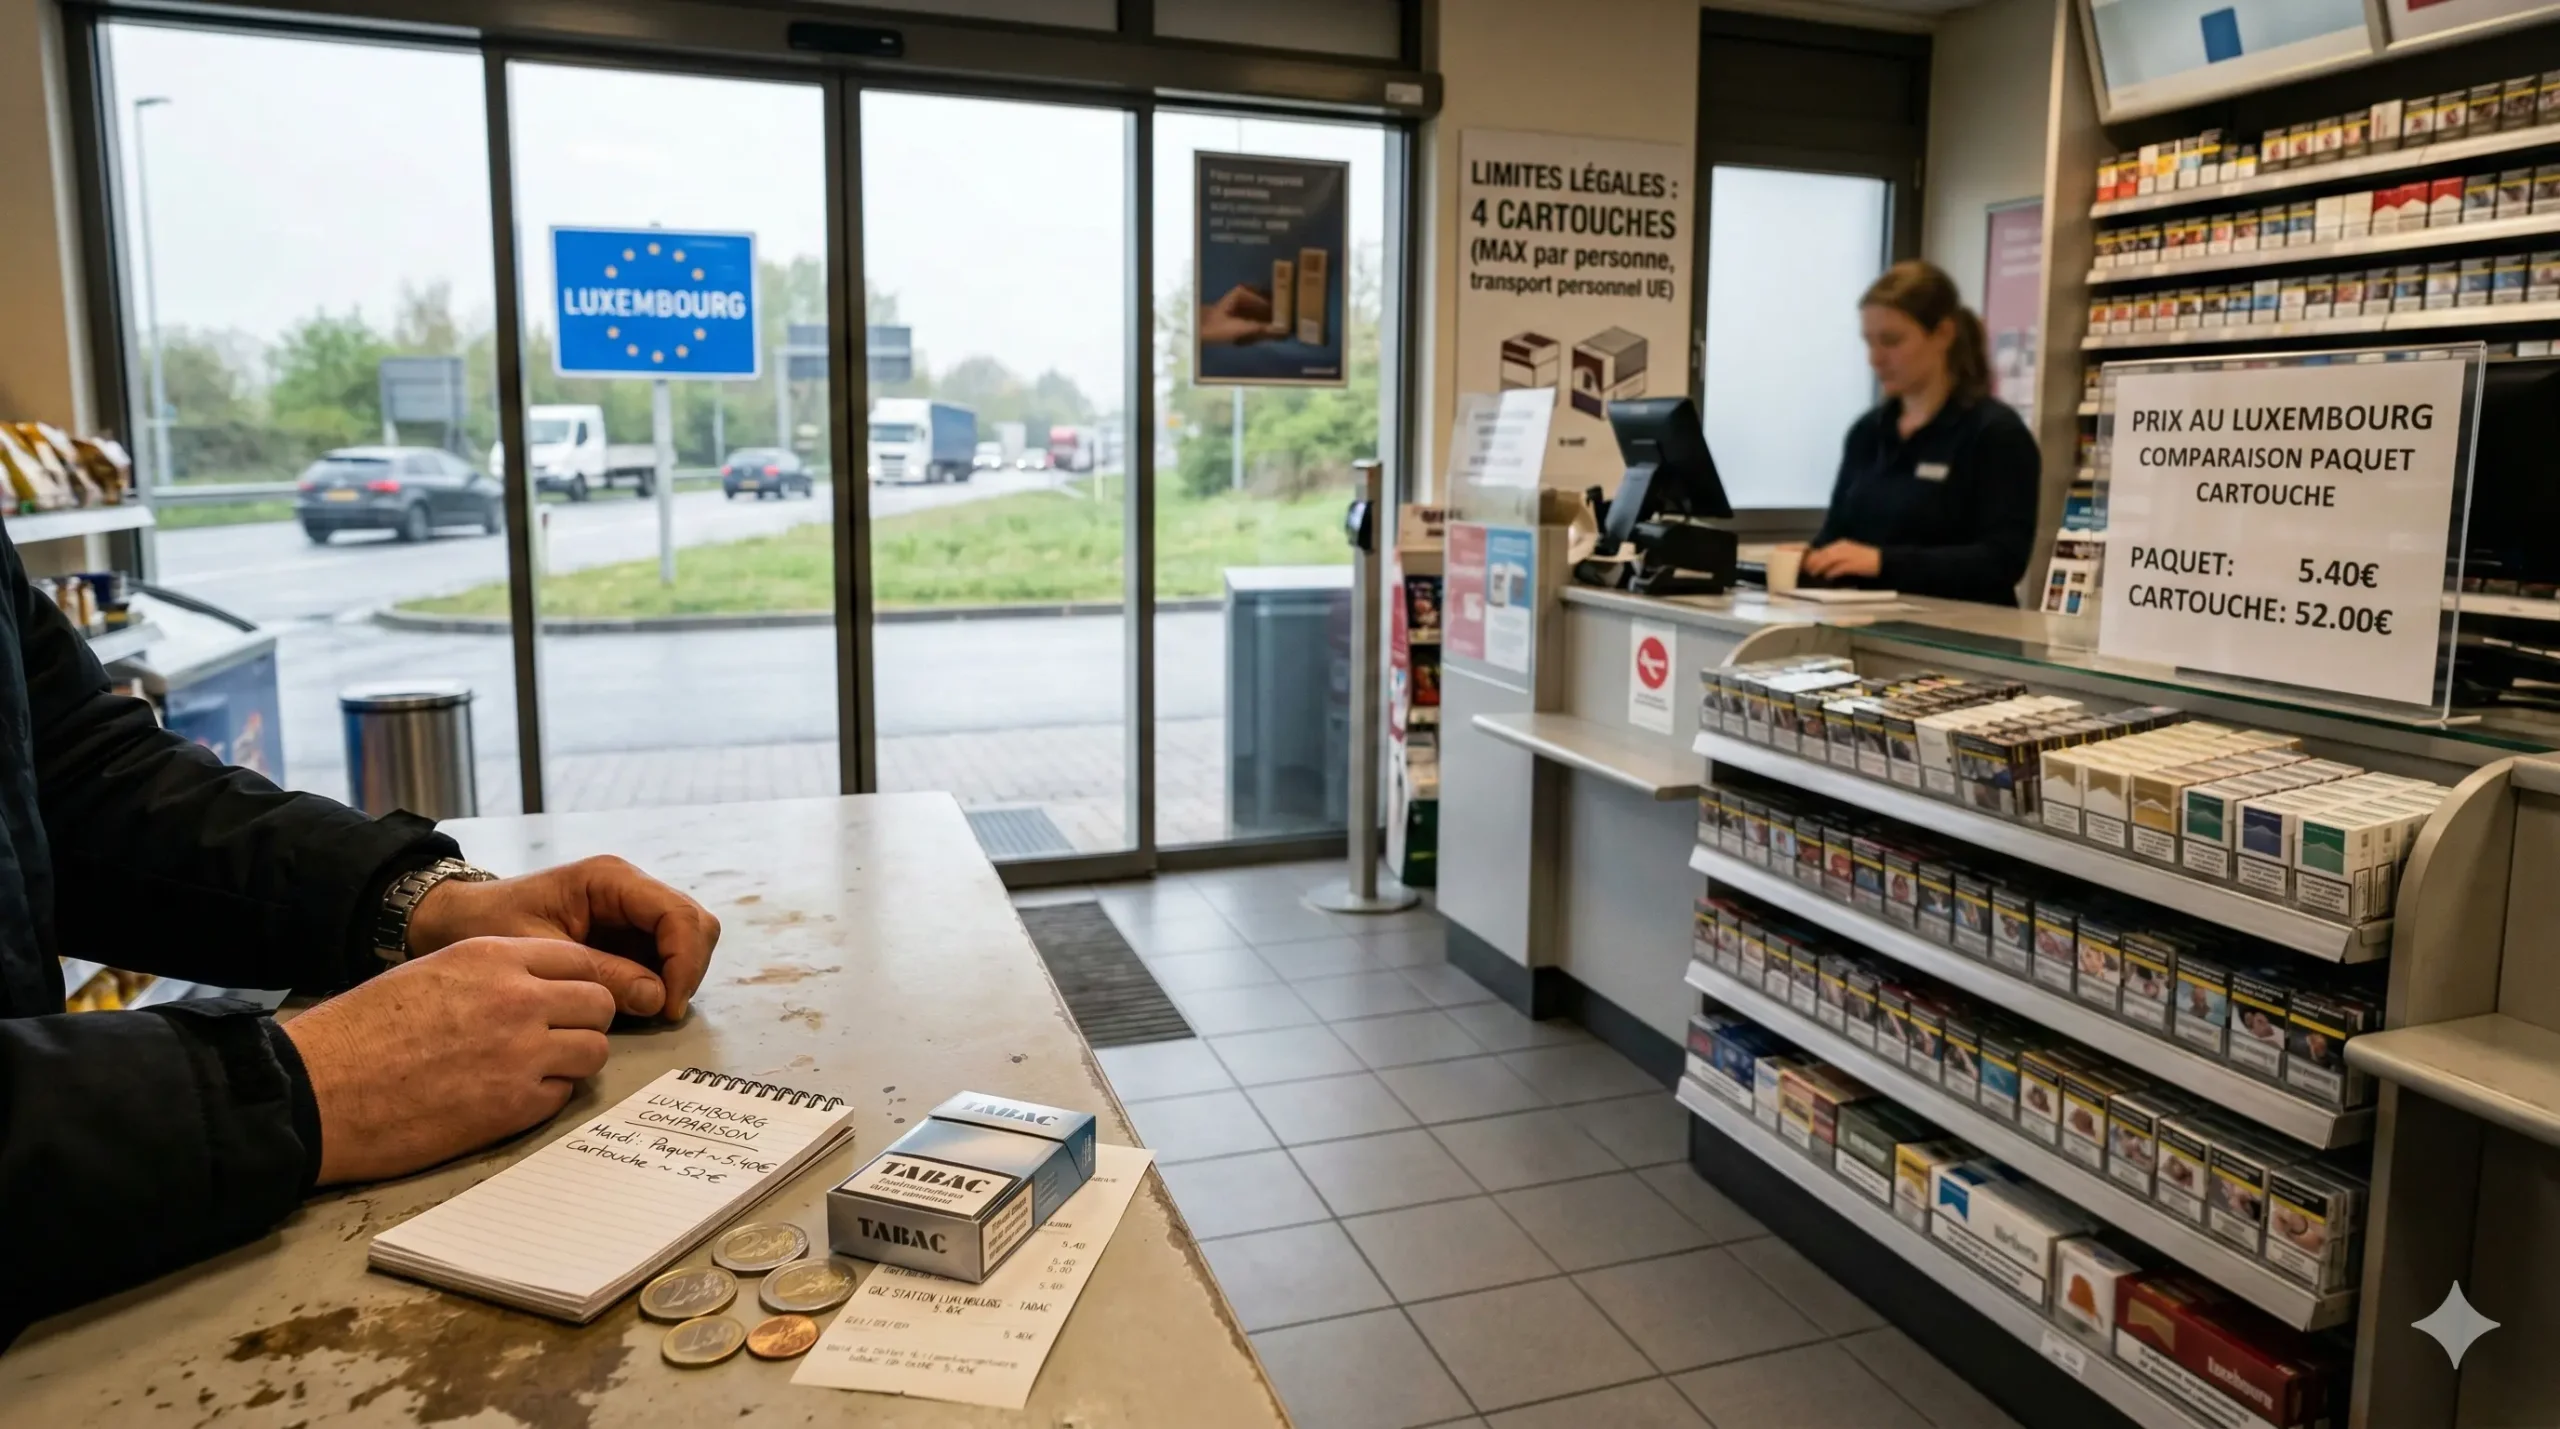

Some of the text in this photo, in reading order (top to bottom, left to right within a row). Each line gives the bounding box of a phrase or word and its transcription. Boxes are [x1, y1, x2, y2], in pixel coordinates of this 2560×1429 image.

[1471, 160, 1563, 190] LIMITES
[1570, 162, 1666, 198] LÉGALES
[1471, 199, 1677, 239] 4 CARTOUCHES
[1470, 237, 1675, 274] (MAX par personne,
[1470, 271, 1675, 302] transport personnel UE)
[563, 287, 747, 320] LUXEMBOURG
[2132, 403, 2434, 433] PRIX AU LUXEMBOURG
[2139, 447, 2416, 476] COMPARAISON PAQUET
[2196, 482, 2337, 508] CARTOUCHE
[2130, 546, 2380, 589] PAQUET: 5.40€
[2128, 584, 2393, 636] CARTOUCHE: 52.00€
[638, 1110, 759, 1142] COMPARISON
[647, 1094, 769, 1129] LUXEMBOURG
[962, 1101, 1059, 1127] TABAC
[566, 1139, 648, 1169] Cartouche
[677, 1166, 729, 1184] 52€
[647, 1137, 707, 1160] Paquet
[880, 1161, 991, 1194] TABAC
[857, 1217, 948, 1254] TABAC
